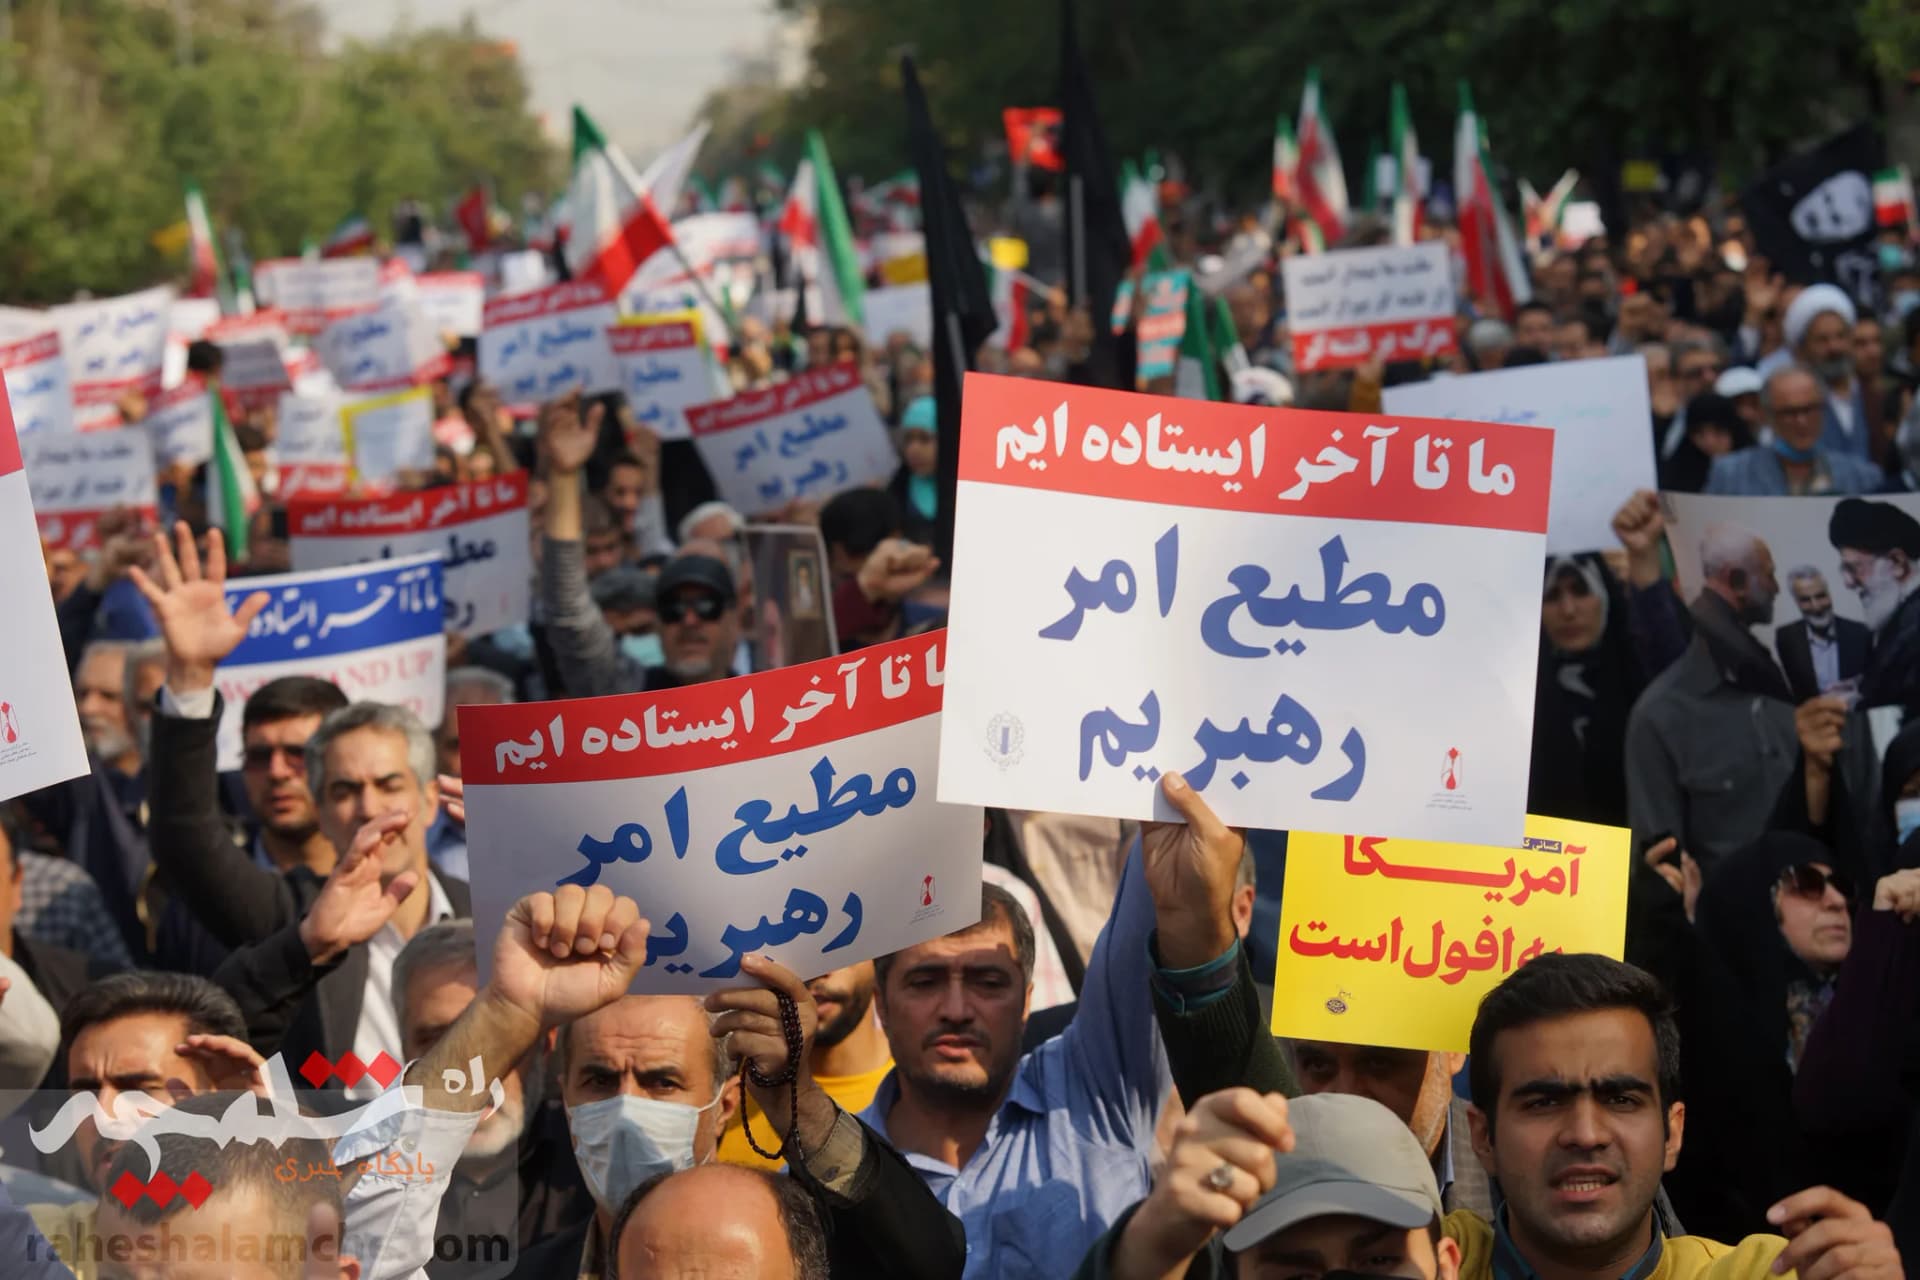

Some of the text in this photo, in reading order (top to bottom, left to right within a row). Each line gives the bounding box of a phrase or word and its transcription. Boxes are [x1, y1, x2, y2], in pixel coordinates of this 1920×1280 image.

[995, 401, 1516, 501] ما تا آخر ایستاده ایم
[1038, 523, 1447, 659] مطیع امر
[770, 657, 866, 743] آخر
[880, 654, 911, 700] تا
[493, 713, 566, 774] ایم
[581, 688, 755, 751] ایستاده
[1078, 689, 1368, 803] رهبریم
[555, 756, 917, 887] مطیع امر
[1343, 834, 1587, 907] آمریکا
[645, 887, 864, 979] رهبری
[1289, 916, 1403, 964] است
[1403, 915, 1514, 985] افول
